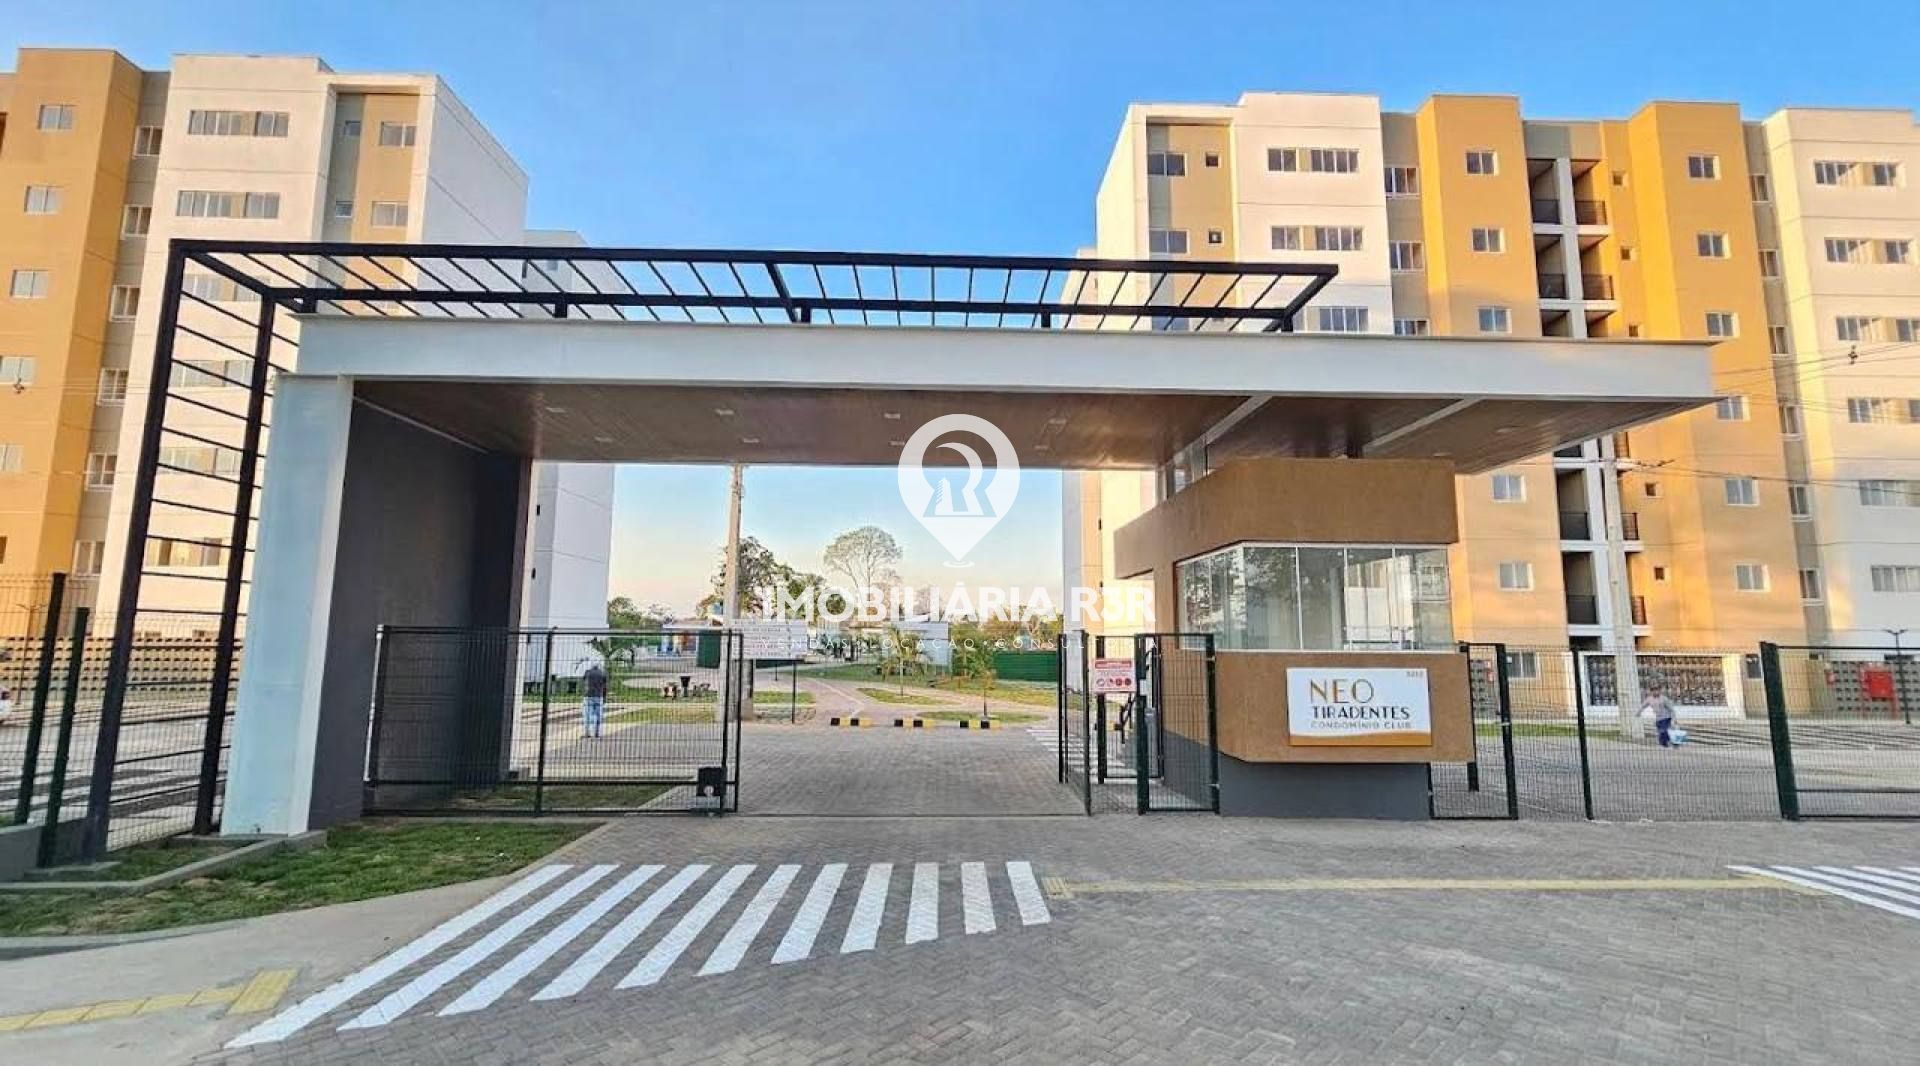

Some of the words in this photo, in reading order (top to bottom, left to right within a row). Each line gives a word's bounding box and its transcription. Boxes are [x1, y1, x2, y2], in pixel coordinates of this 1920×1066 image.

[1310, 679, 1374, 703] NEO
[1312, 705, 1410, 720] TIRADENTES
[1384, 720, 1412, 729] CLUB
